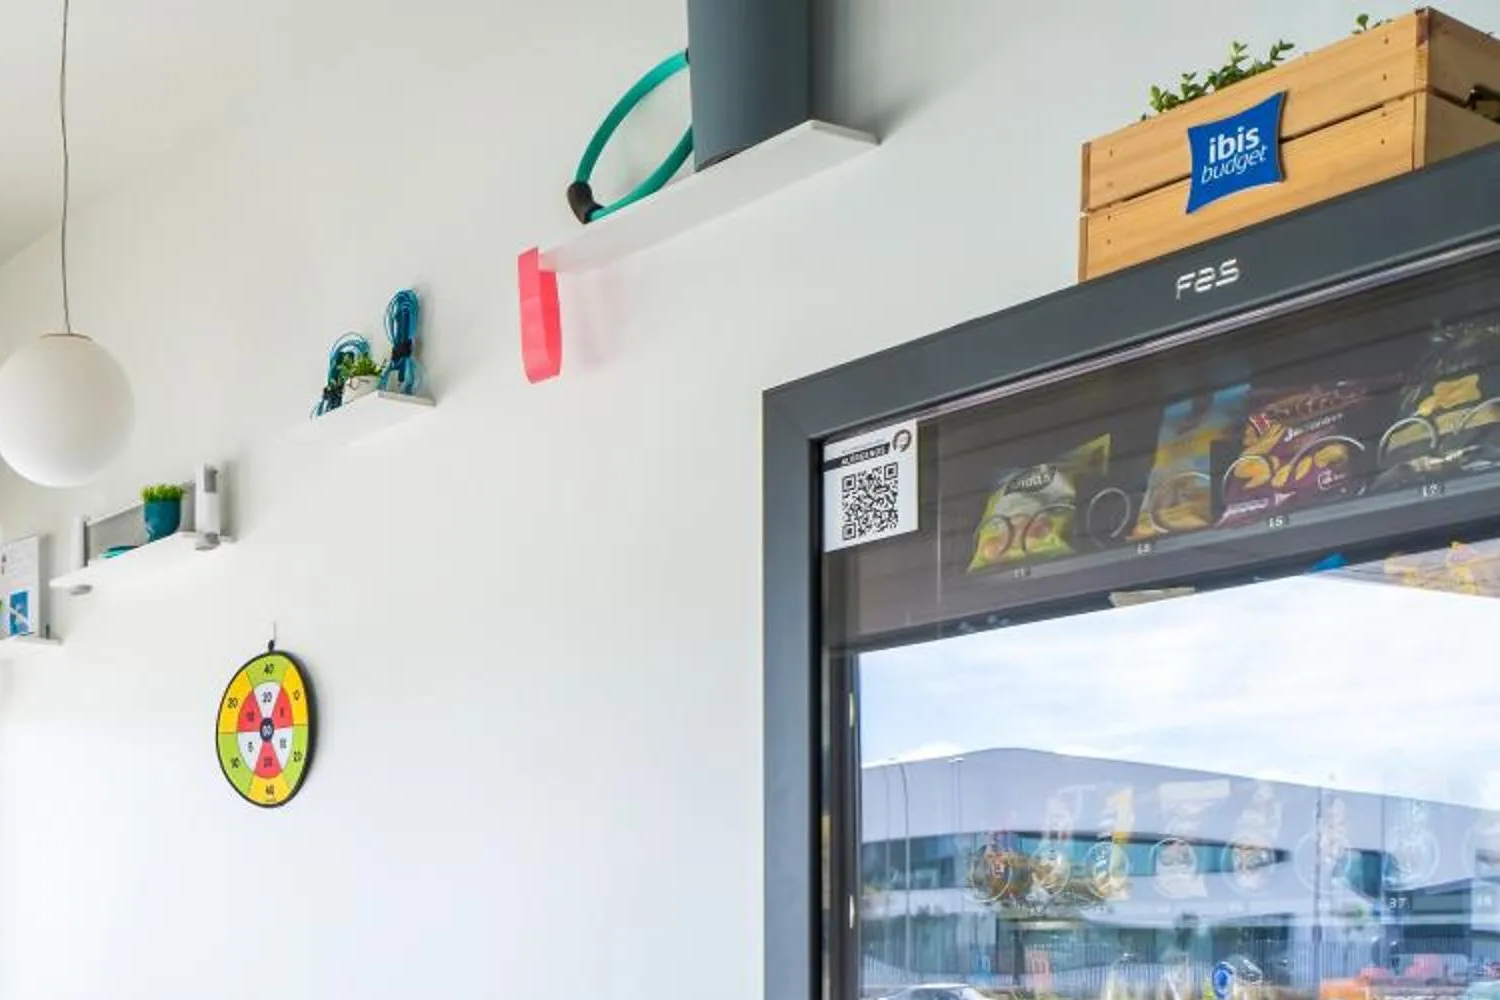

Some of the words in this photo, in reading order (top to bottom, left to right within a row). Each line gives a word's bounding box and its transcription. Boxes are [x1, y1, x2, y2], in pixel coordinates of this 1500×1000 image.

[1209, 126, 1260, 164] ibis
[1201, 145, 1268, 184] budget
[264, 663, 274, 675] 40
